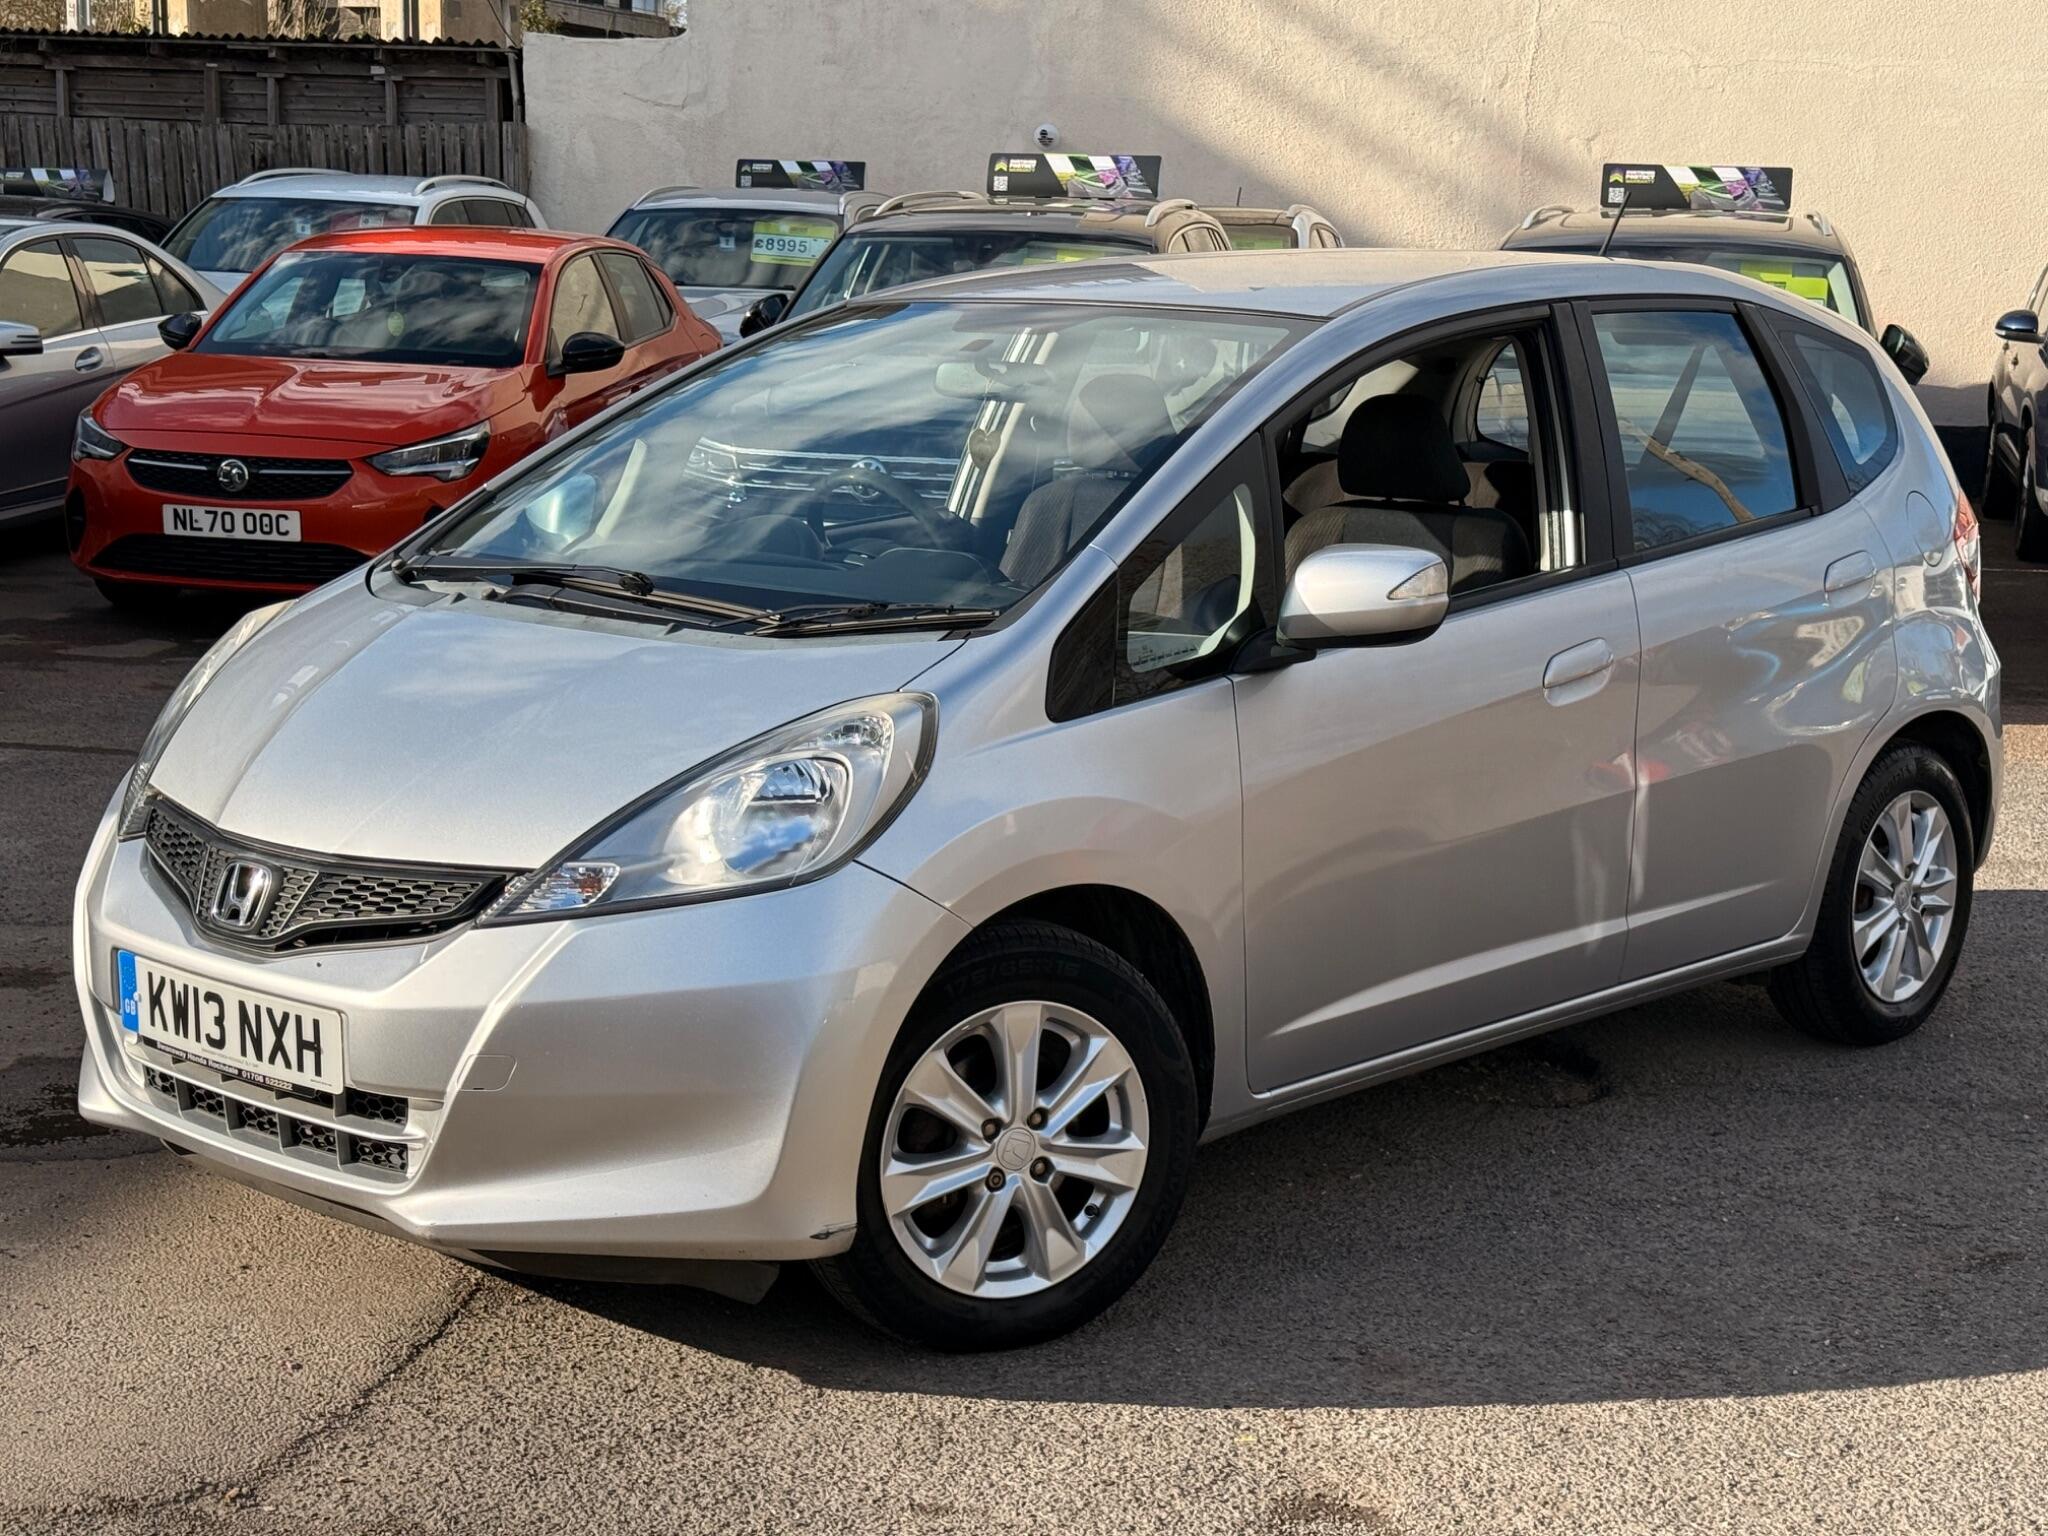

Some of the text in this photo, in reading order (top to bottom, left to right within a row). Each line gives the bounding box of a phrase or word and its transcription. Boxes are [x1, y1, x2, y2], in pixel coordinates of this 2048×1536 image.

[754, 238, 808, 253] £8995
[173, 507, 235, 534] NL70
[124, 998, 137, 1016] GB
[147, 971, 322, 1078] KW13 NXH
